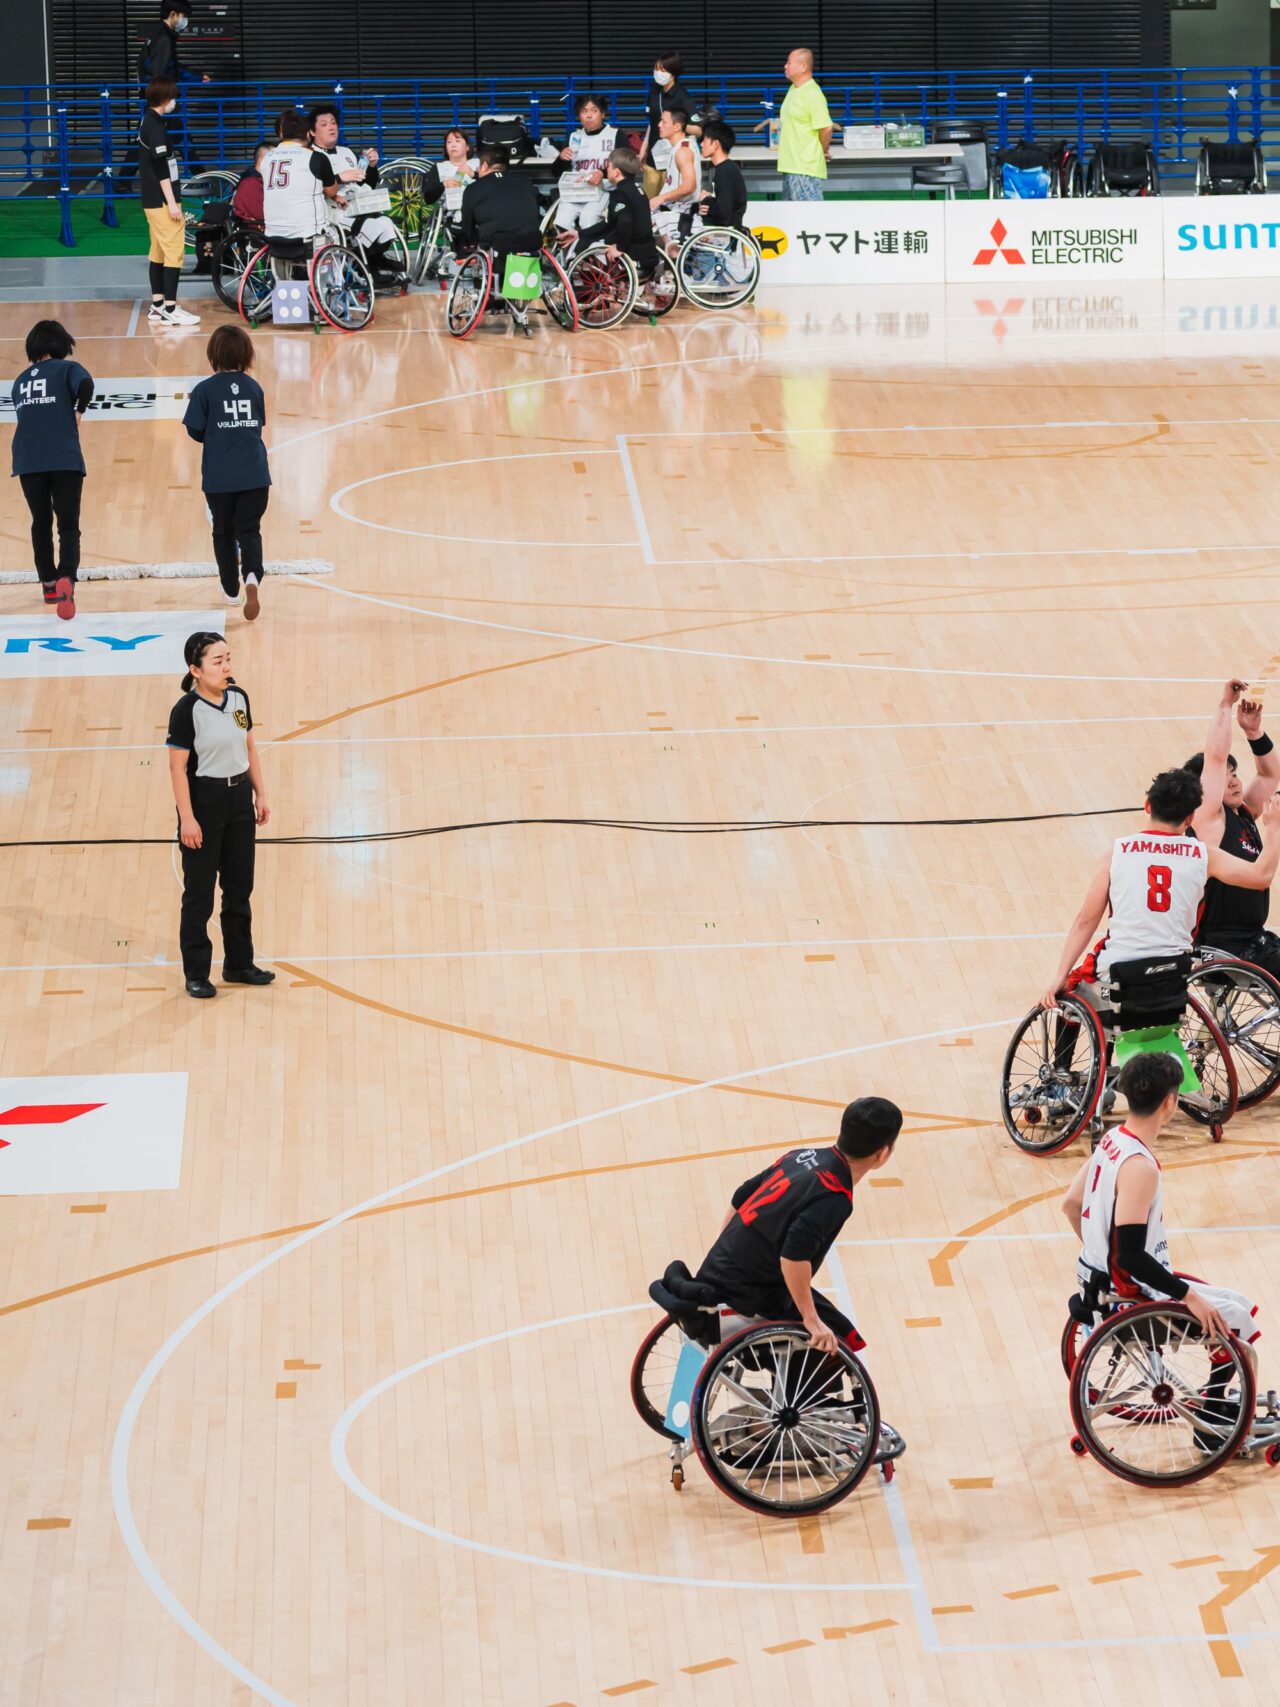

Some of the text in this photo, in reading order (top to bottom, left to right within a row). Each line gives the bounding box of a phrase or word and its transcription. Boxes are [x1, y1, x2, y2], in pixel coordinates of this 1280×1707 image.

[601, 139, 613, 152] 12
[267, 158, 292, 190] 15
[796, 230, 929, 255] ヤマト運輸
[1031, 228, 1138, 247] MITSUBISHI
[1031, 247, 1124, 265] ELECTRIC
[20, 379, 47, 398] 49
[223, 400, 252, 420] 49
[217, 420, 259, 429] VOLUNTEER
[1121, 840, 1202, 859] YAMASHITA
[1147, 864, 1172, 912] 8
